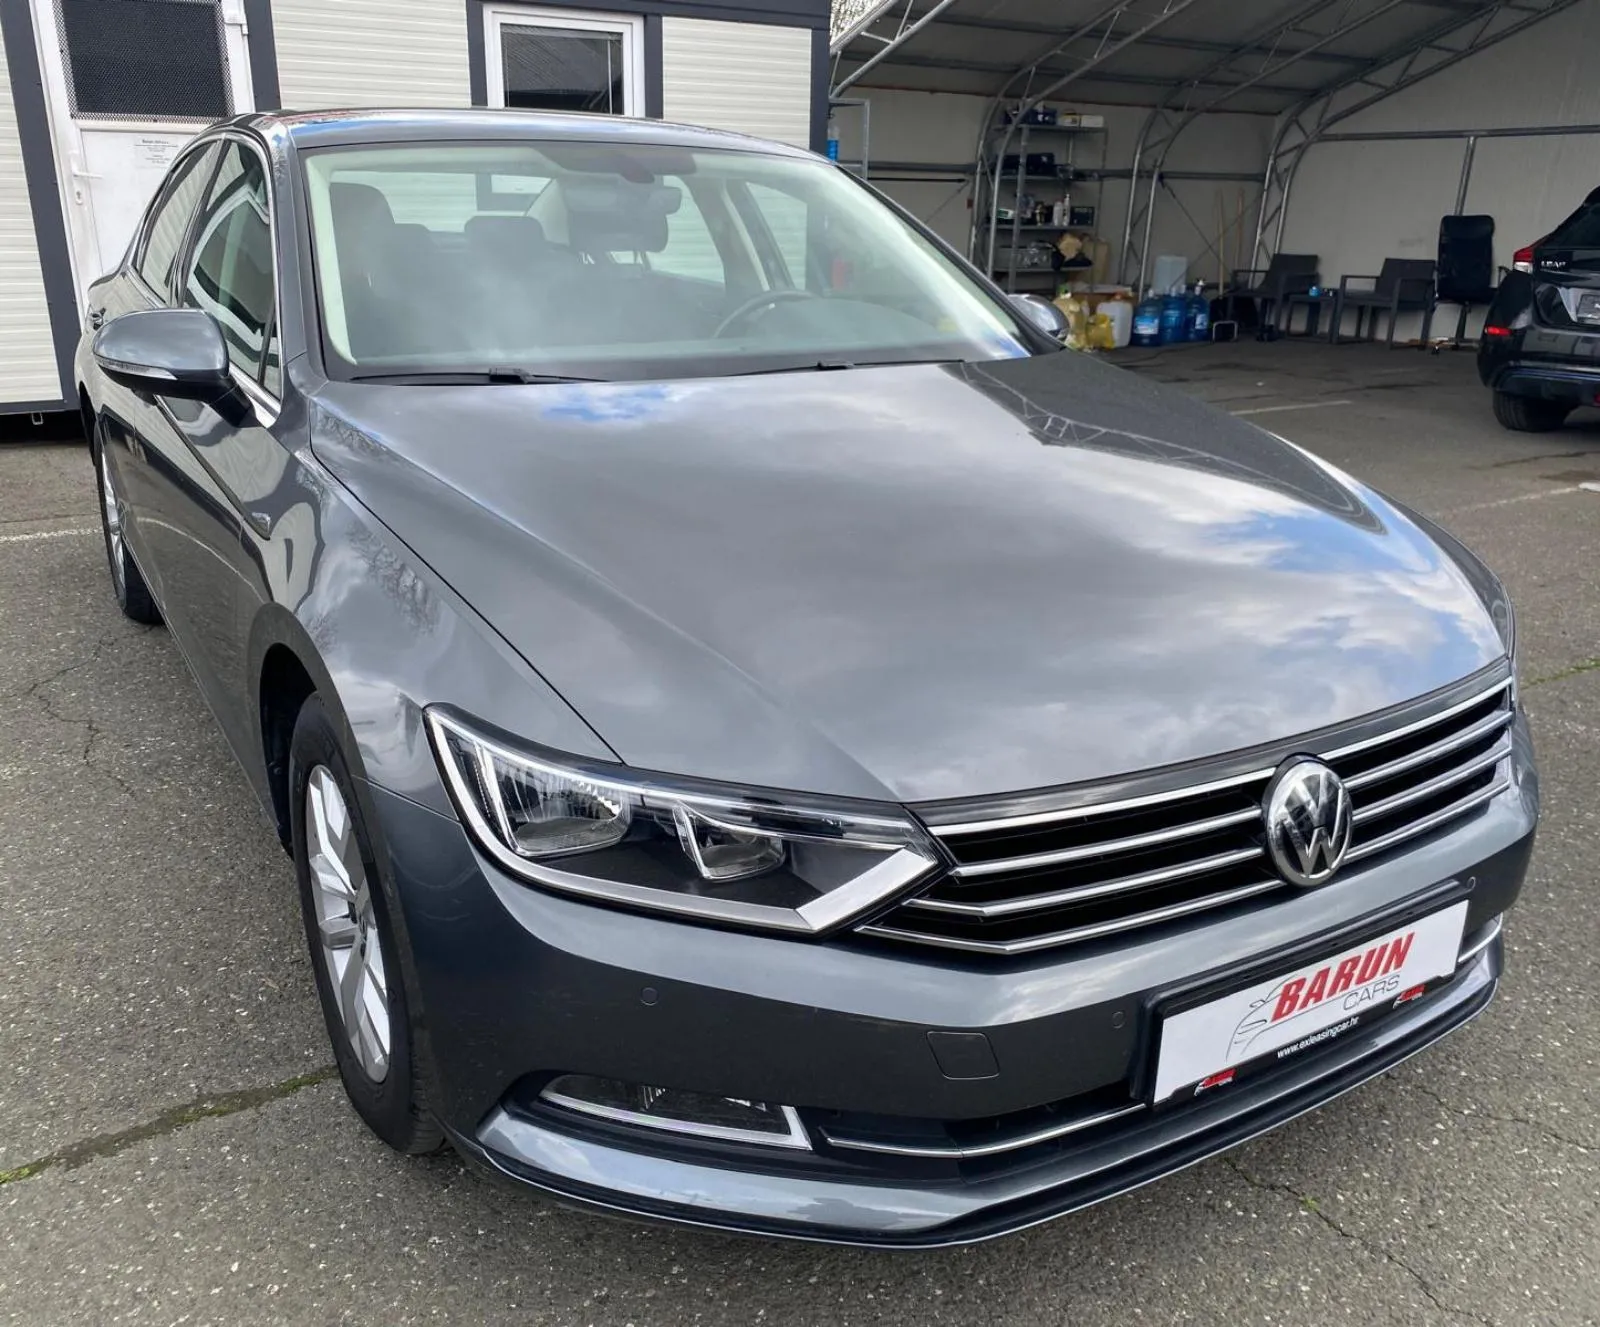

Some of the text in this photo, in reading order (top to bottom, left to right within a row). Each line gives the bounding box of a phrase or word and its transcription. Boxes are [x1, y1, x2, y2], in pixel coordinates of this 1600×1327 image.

[1270, 931, 1416, 1023] BARUN
[1342, 974, 1400, 1012] CARS
[1277, 1015, 1360, 1059] www.exleasingcar.hr
